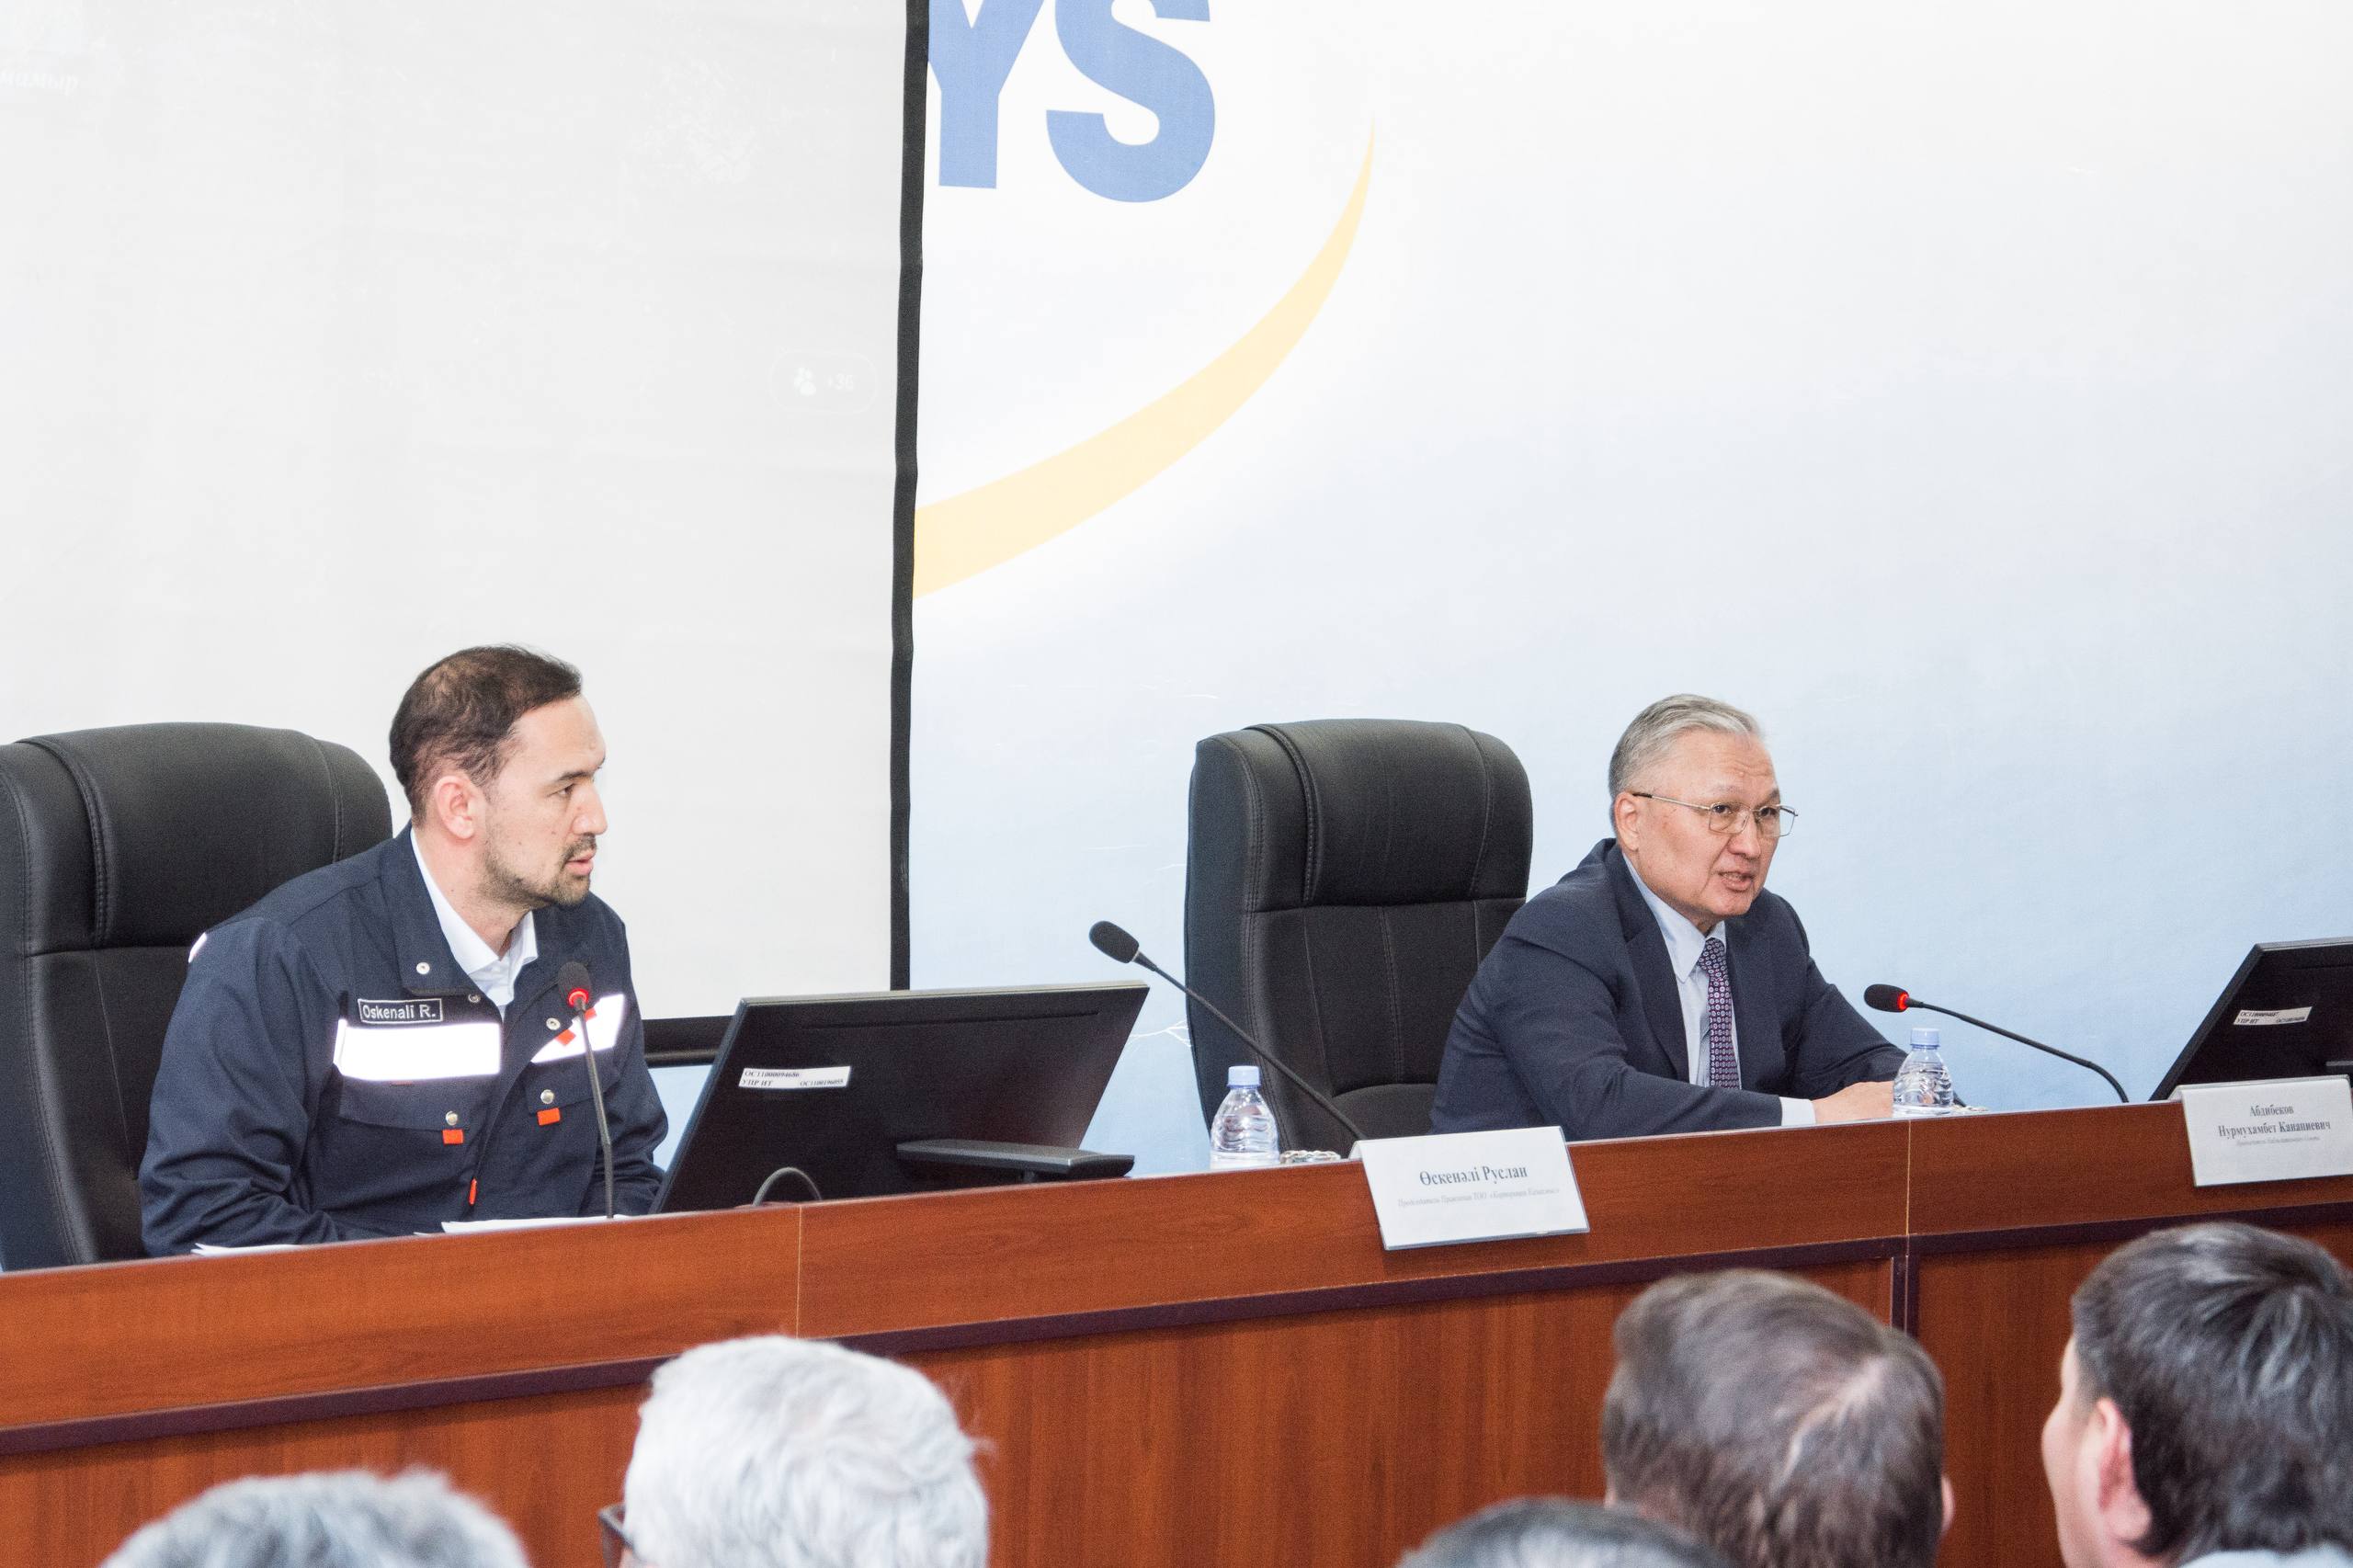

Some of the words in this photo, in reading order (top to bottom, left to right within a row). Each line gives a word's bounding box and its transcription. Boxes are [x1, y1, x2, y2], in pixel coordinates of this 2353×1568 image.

[362, 1005, 415, 1019] Oskenali
[419, 1004, 436, 1018] R.
[2249, 1105, 2294, 1118] Абдибеков
[2218, 1123, 2277, 1140] Нурмухамбет
[1419, 1166, 1480, 1186] Өскенәлі
[1482, 1165, 1528, 1184] Руслан
